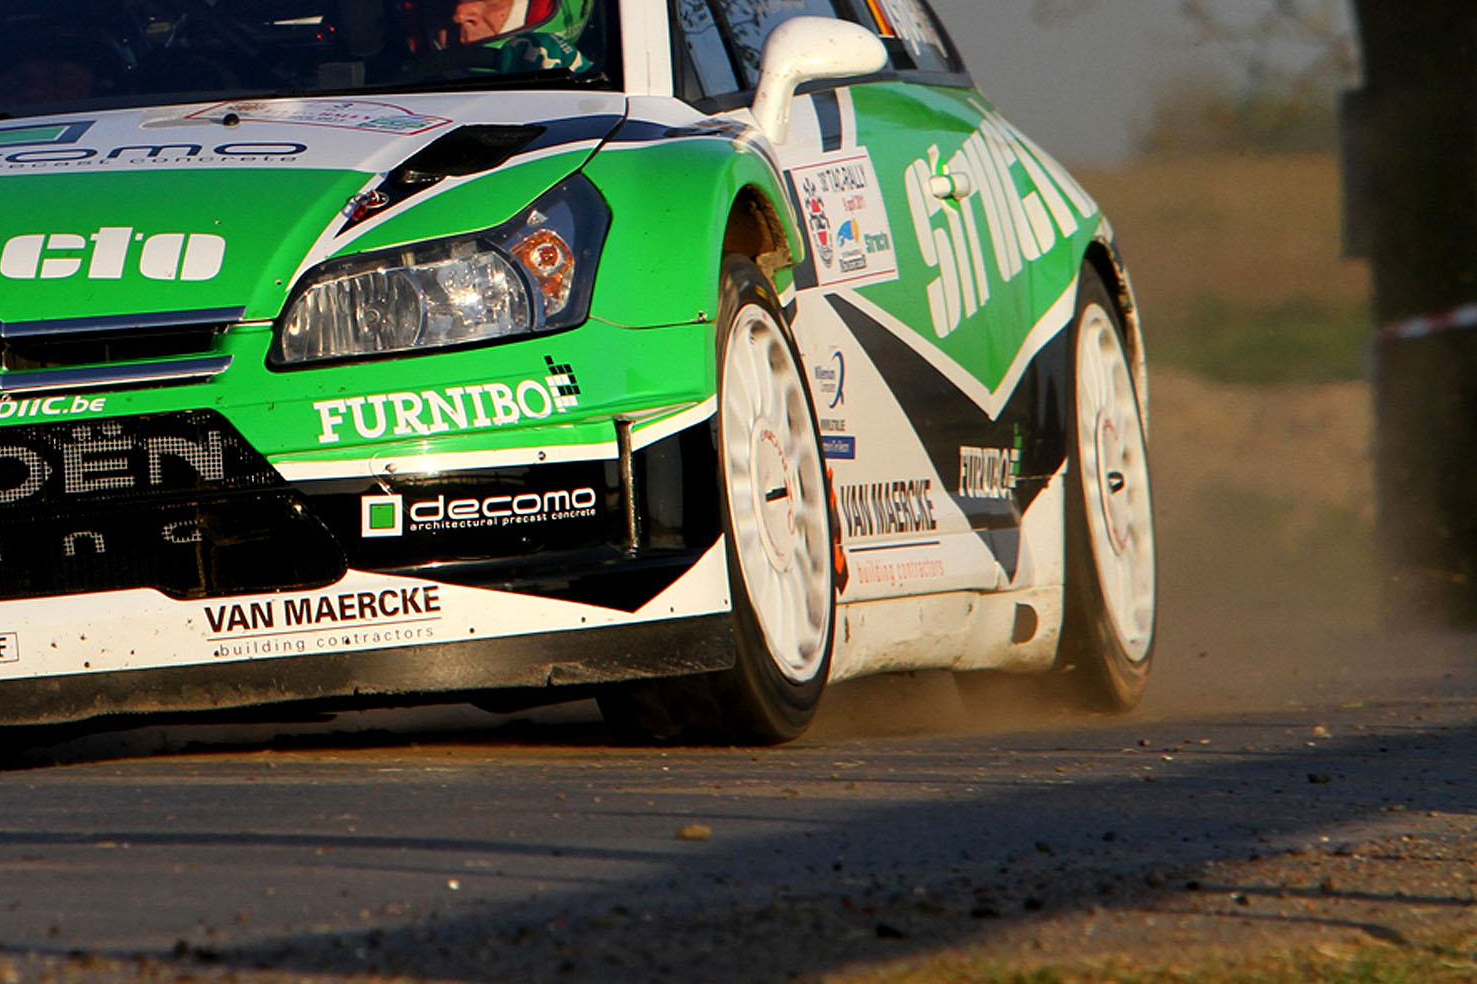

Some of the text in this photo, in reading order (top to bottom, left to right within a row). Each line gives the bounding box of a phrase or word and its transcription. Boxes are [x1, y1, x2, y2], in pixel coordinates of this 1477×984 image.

[312, 377, 554, 444] FURNIBO
[409, 507, 597, 532] architectural precast concrete
[410, 486, 597, 523] decomo
[840, 479, 937, 538] VAN MAERCKE
[204, 585, 442, 635] VAN MAERCKE
[219, 625, 435, 658] building contractors
